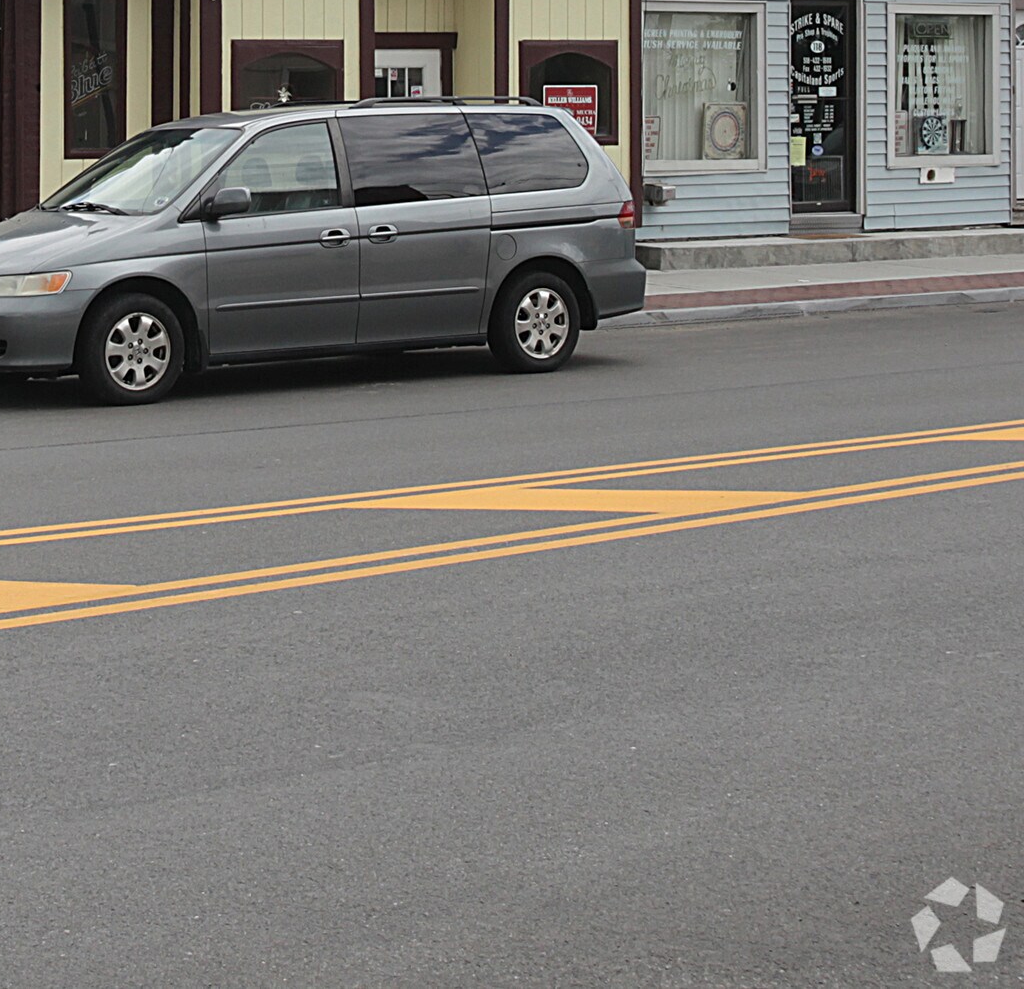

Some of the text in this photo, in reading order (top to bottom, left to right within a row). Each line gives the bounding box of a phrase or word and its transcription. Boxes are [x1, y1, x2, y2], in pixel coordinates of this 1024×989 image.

[791, 12, 844, 36] STRIKE & SPARE
[916, 22, 950, 35] OPEN
[666, 40, 699, 50] SERVICE
[703, 41, 742, 51] AVAILABLE
[824, 67, 844, 85] Sports
[71, 66, 113, 104] Blue
[568, 96, 592, 104] WILLIAMS
